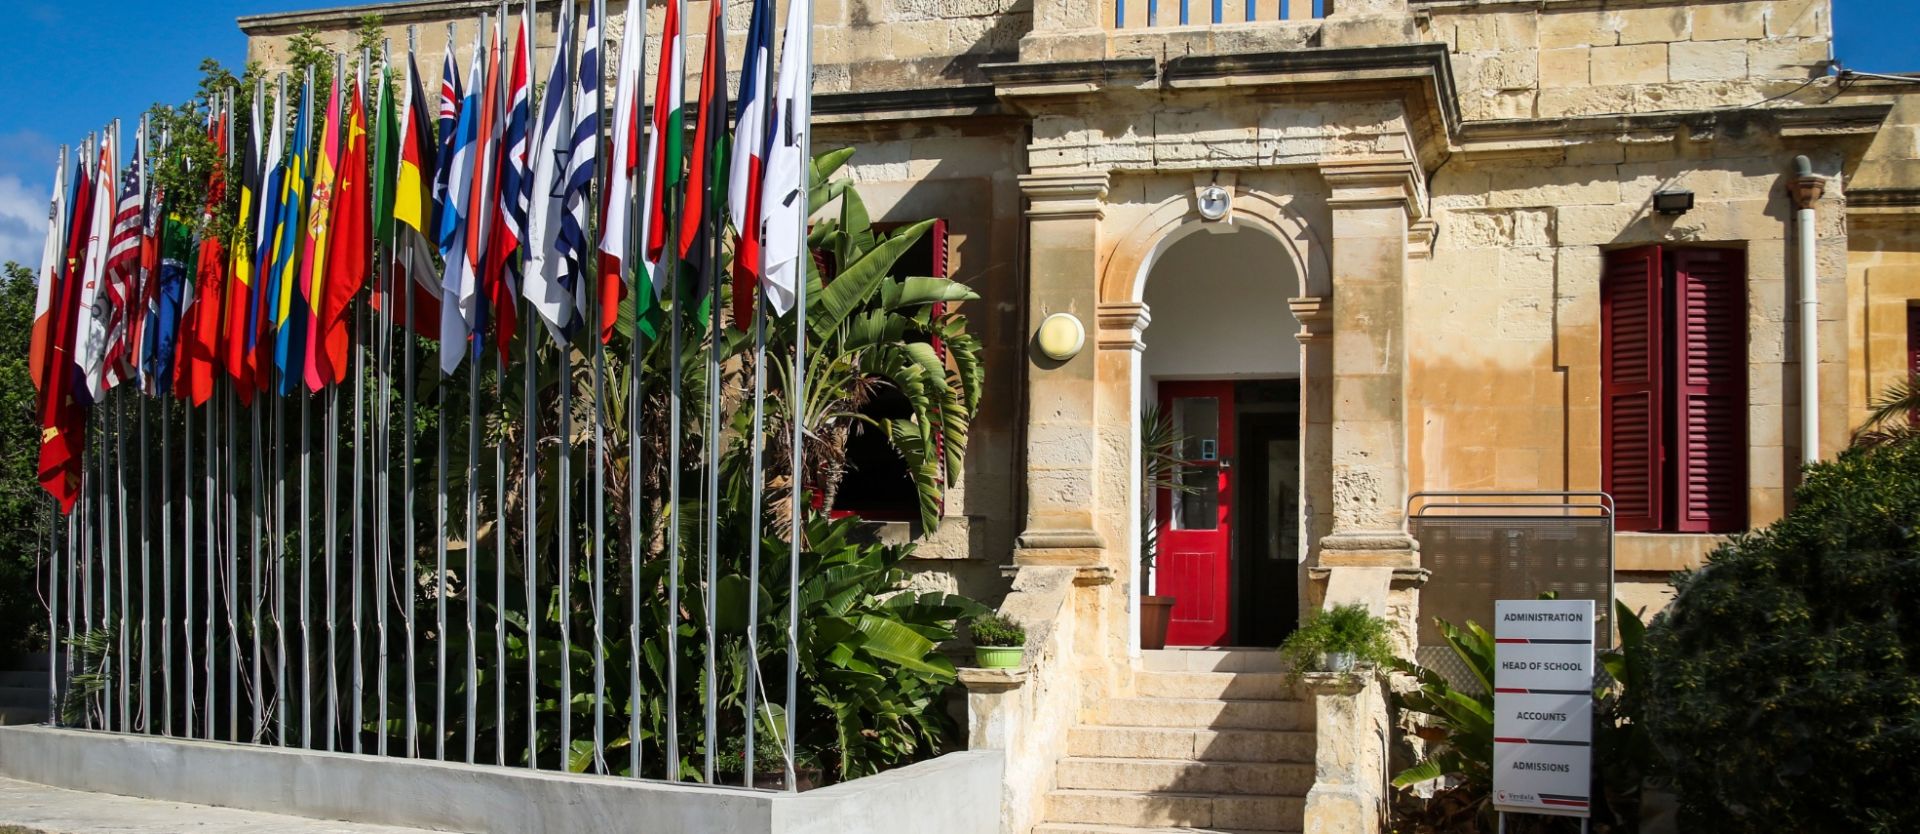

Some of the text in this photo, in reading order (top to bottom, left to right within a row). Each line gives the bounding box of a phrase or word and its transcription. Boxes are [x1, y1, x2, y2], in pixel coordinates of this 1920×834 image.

[1504, 613, 1583, 622] ADMINISTRATION
[1502, 661, 1582, 671] HEAD OF SCHOOL
[1516, 711, 1567, 721] ACCOUNTS
[1512, 761, 1569, 772] ADMISSIONS
